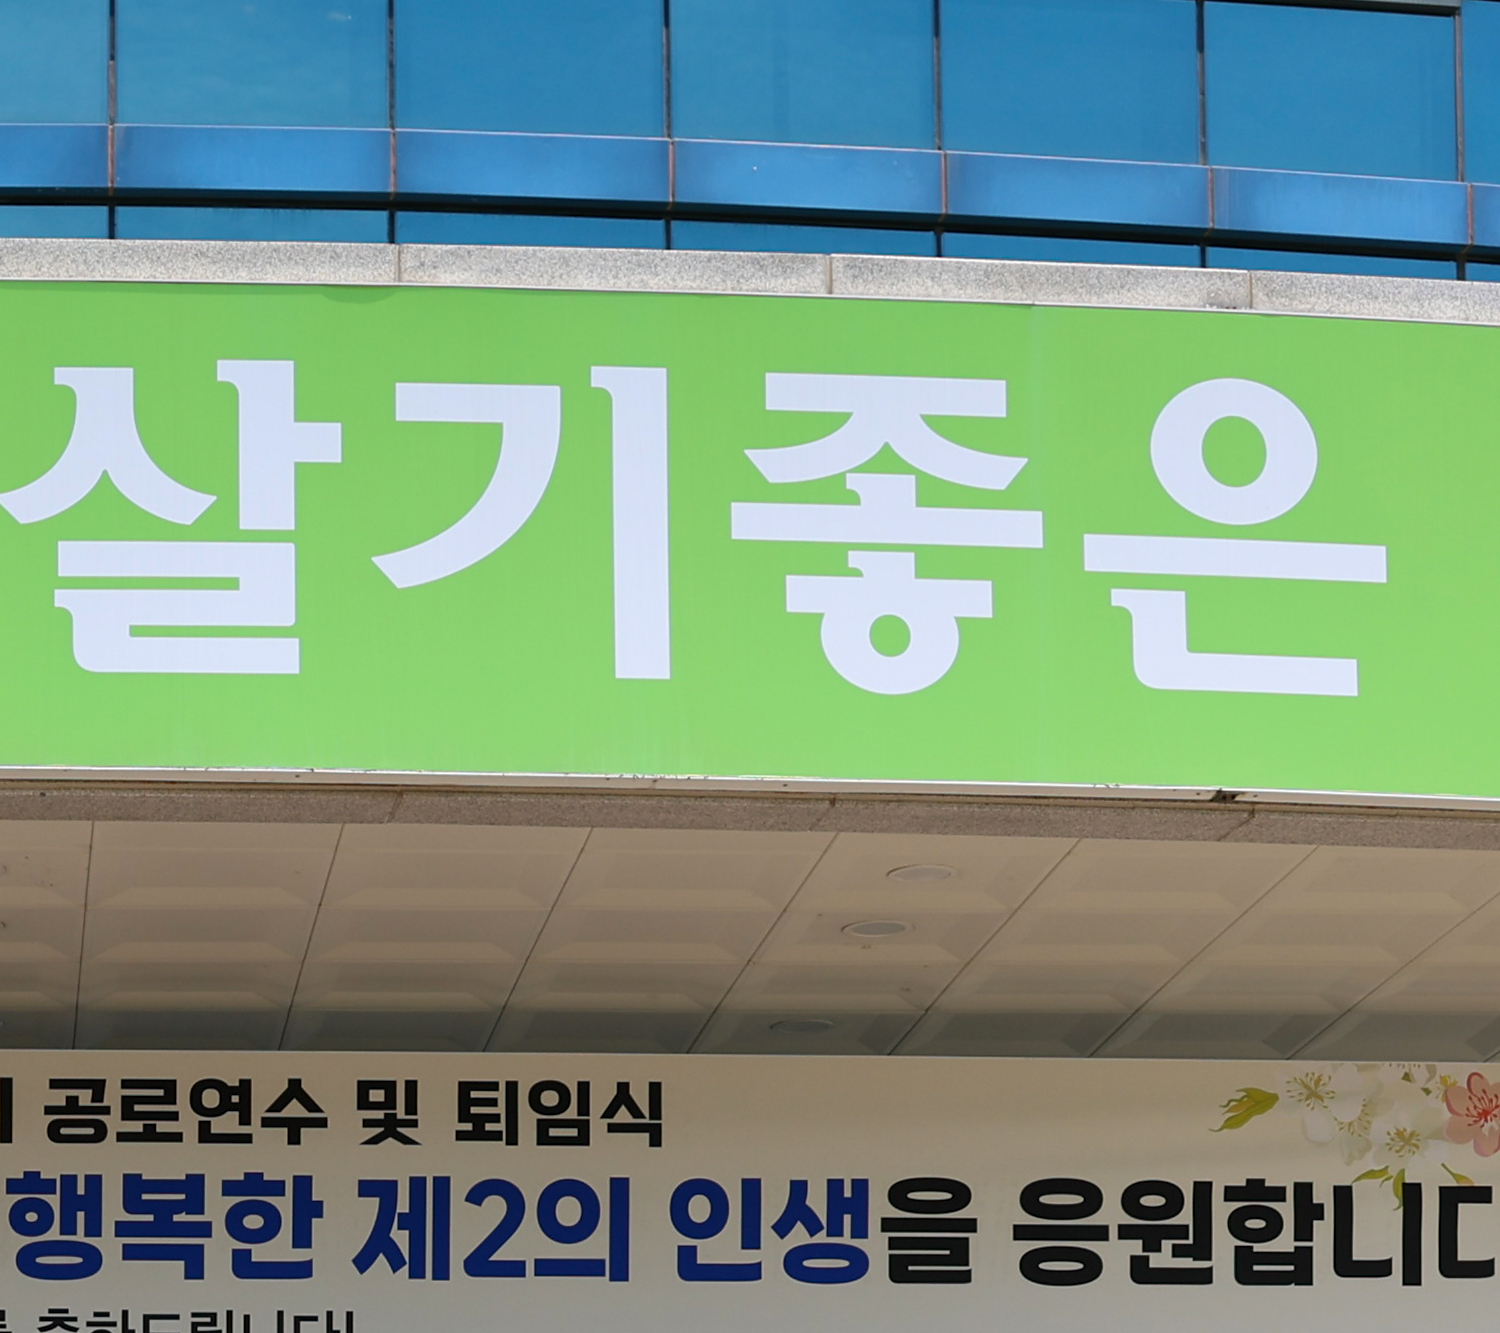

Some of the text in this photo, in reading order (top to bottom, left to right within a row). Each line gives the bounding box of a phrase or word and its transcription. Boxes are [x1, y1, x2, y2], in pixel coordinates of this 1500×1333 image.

[43, 1078, 328, 1145] 공로연수
[356, 1079, 420, 1145] 및
[455, 1079, 662, 1147] 퇴임식
[5, 1171, 323, 1280] 행복한
[352, 1176, 629, 1281] 제2의
[669, 1177, 977, 1284] 인생을
